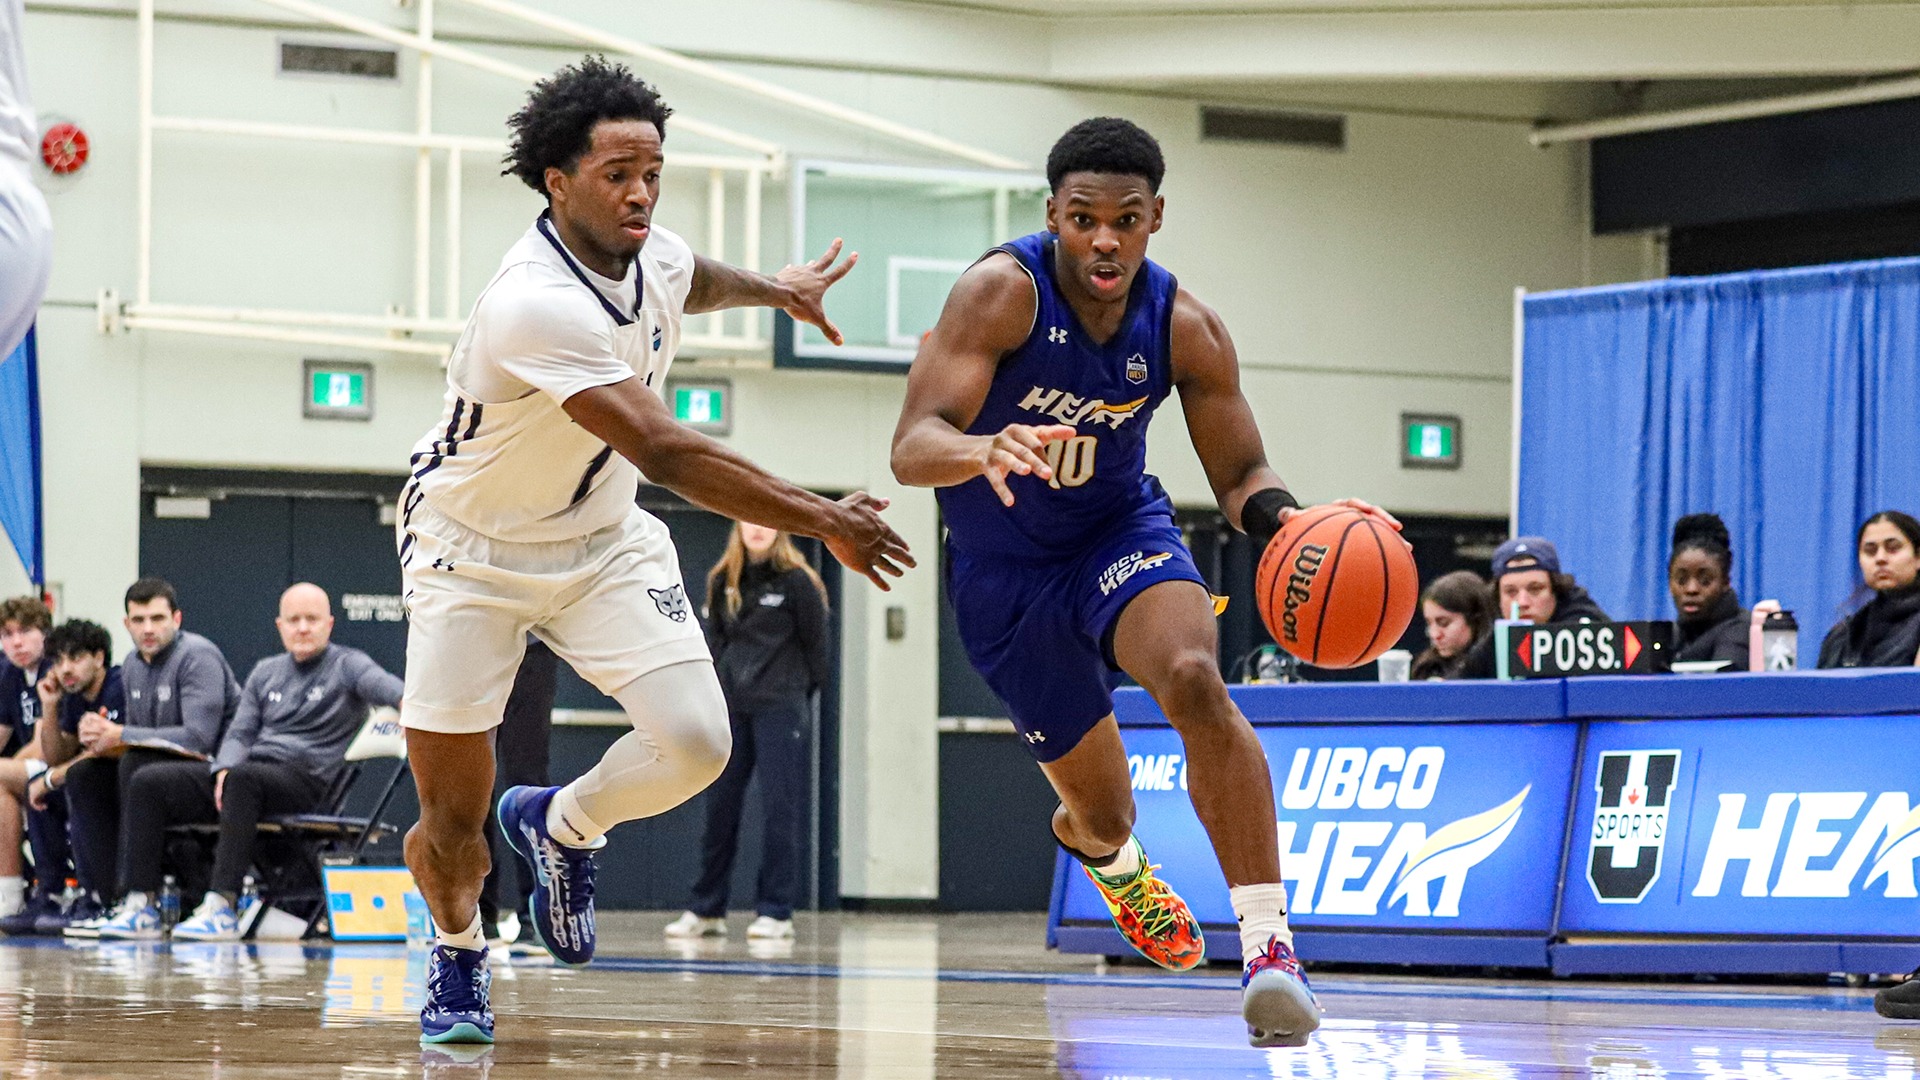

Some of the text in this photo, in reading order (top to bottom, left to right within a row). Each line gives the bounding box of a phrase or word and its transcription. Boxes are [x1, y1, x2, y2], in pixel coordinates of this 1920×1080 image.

[1128, 370, 1145, 379] WEST
[1017, 385, 1149, 430] HEAT
[1100, 552, 1173, 596] HEAT
[1282, 543, 1330, 643] Wilson
[342, 594, 403, 609] EMERGENC
[1533, 627, 1621, 672] POSS.
[1128, 754, 1181, 791] OME
[1282, 746, 1445, 809] UBCO
[1591, 752, 1679, 900] U
[1595, 814, 1664, 839] SPORTS
[1691, 791, 1920, 899] HEA
[1277, 784, 1532, 917] HEAT
